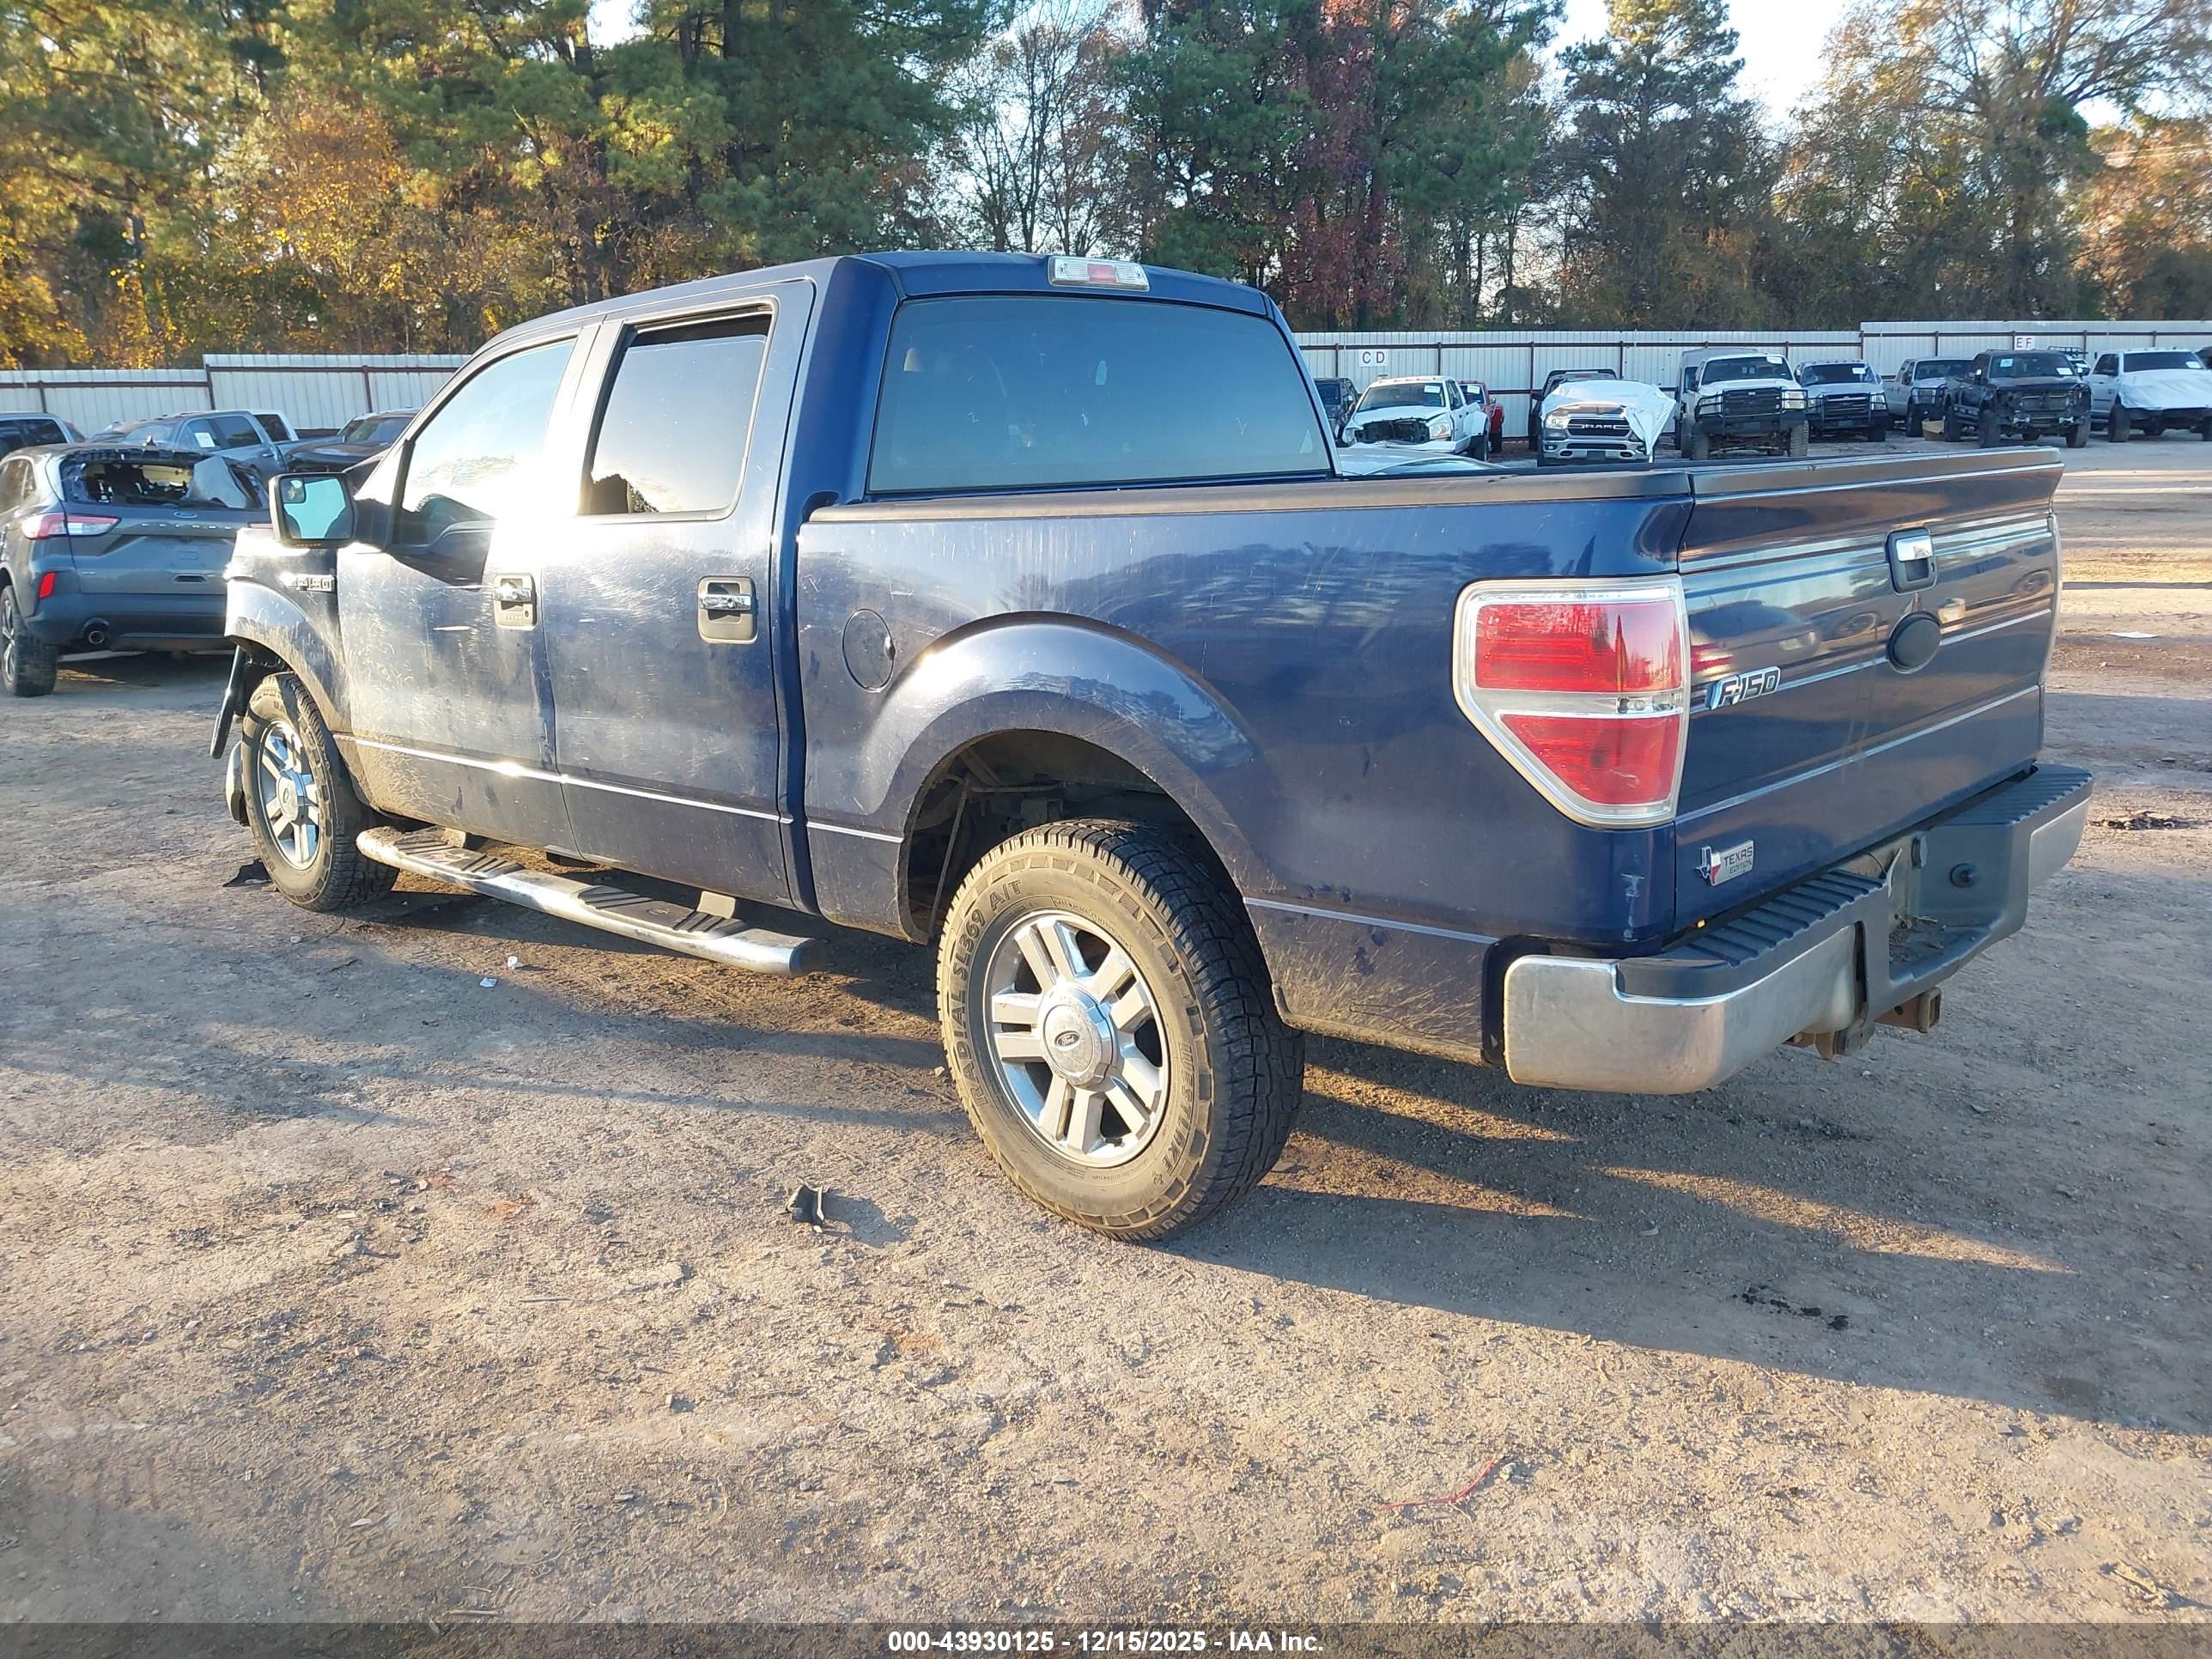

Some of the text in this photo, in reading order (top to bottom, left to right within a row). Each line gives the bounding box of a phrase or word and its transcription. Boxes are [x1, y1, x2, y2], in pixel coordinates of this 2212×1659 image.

[1715, 666, 1781, 707] F-150
[1723, 846, 1753, 866] TEXAS
[989, 878, 1022, 911] A/T
[952, 908, 986, 981] SL369
[950, 988, 988, 1107] RADIAL
[1162, 1042, 1195, 1176] WESTLAKE
